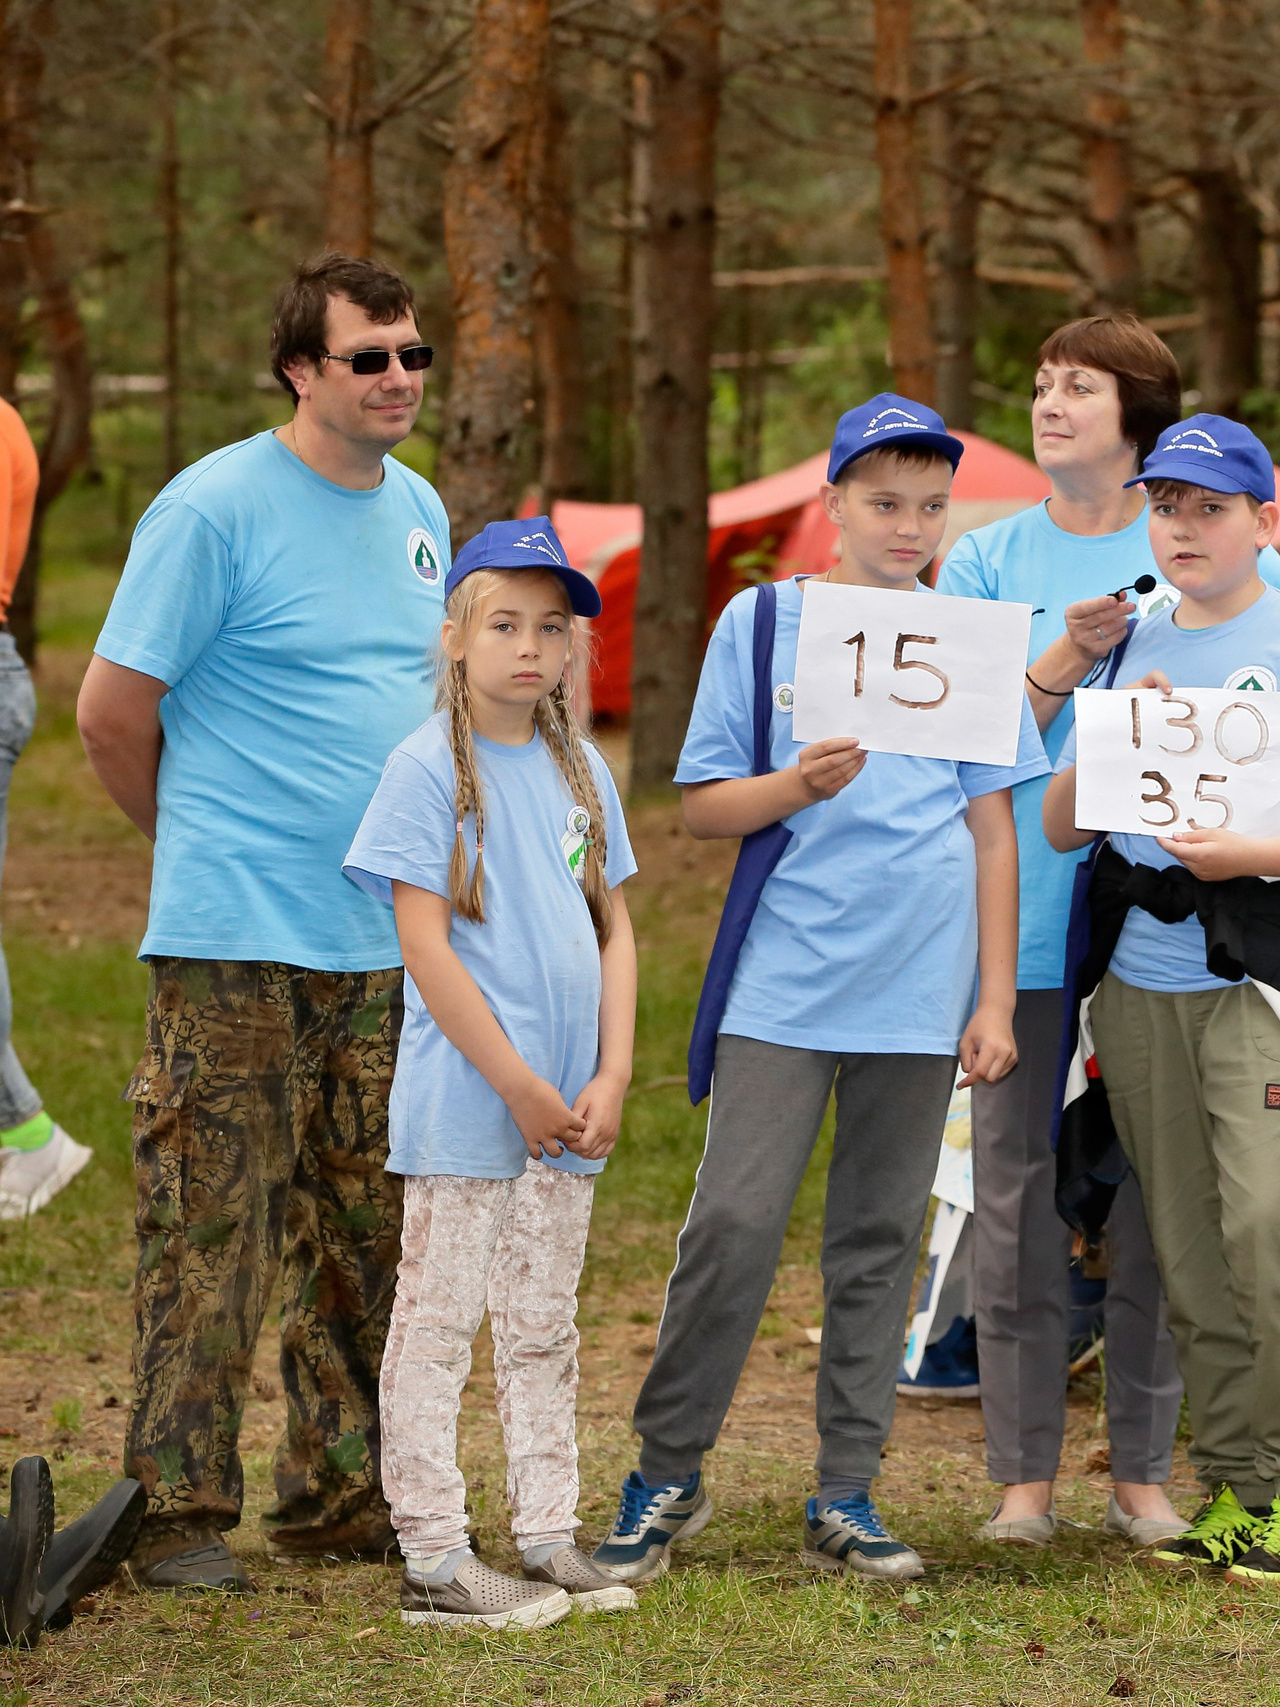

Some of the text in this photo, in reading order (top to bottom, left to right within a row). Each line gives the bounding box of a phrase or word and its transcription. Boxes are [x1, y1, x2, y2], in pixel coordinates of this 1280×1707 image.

[842, 631, 950, 710] 15
[1131, 696, 1270, 766] 130
[1138, 771, 1235, 830] 35
